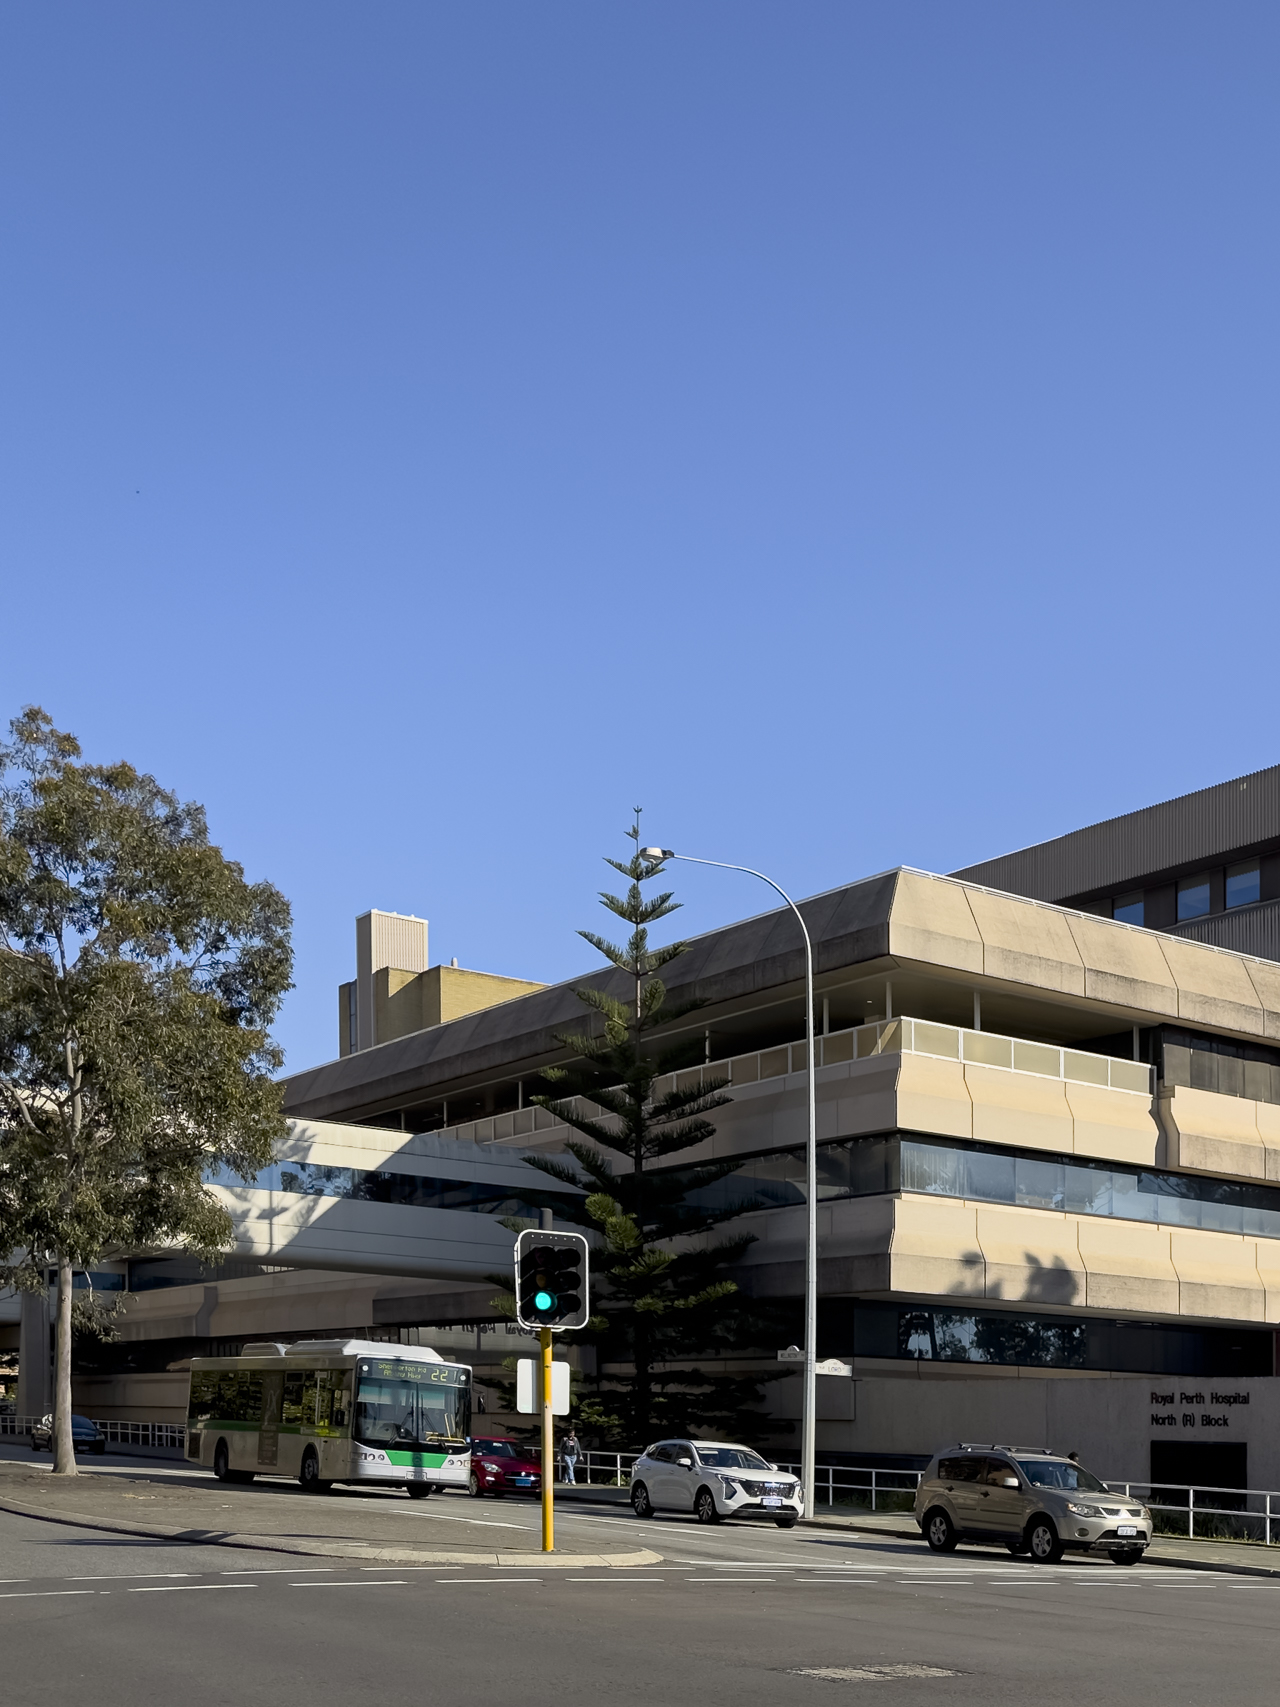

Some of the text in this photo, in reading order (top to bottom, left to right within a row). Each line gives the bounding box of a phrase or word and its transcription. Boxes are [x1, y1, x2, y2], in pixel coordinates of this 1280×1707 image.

[1150, 1392, 1250, 1406] Royal Perth Hospital
[1151, 1412, 1229, 1428] North (R) Block
